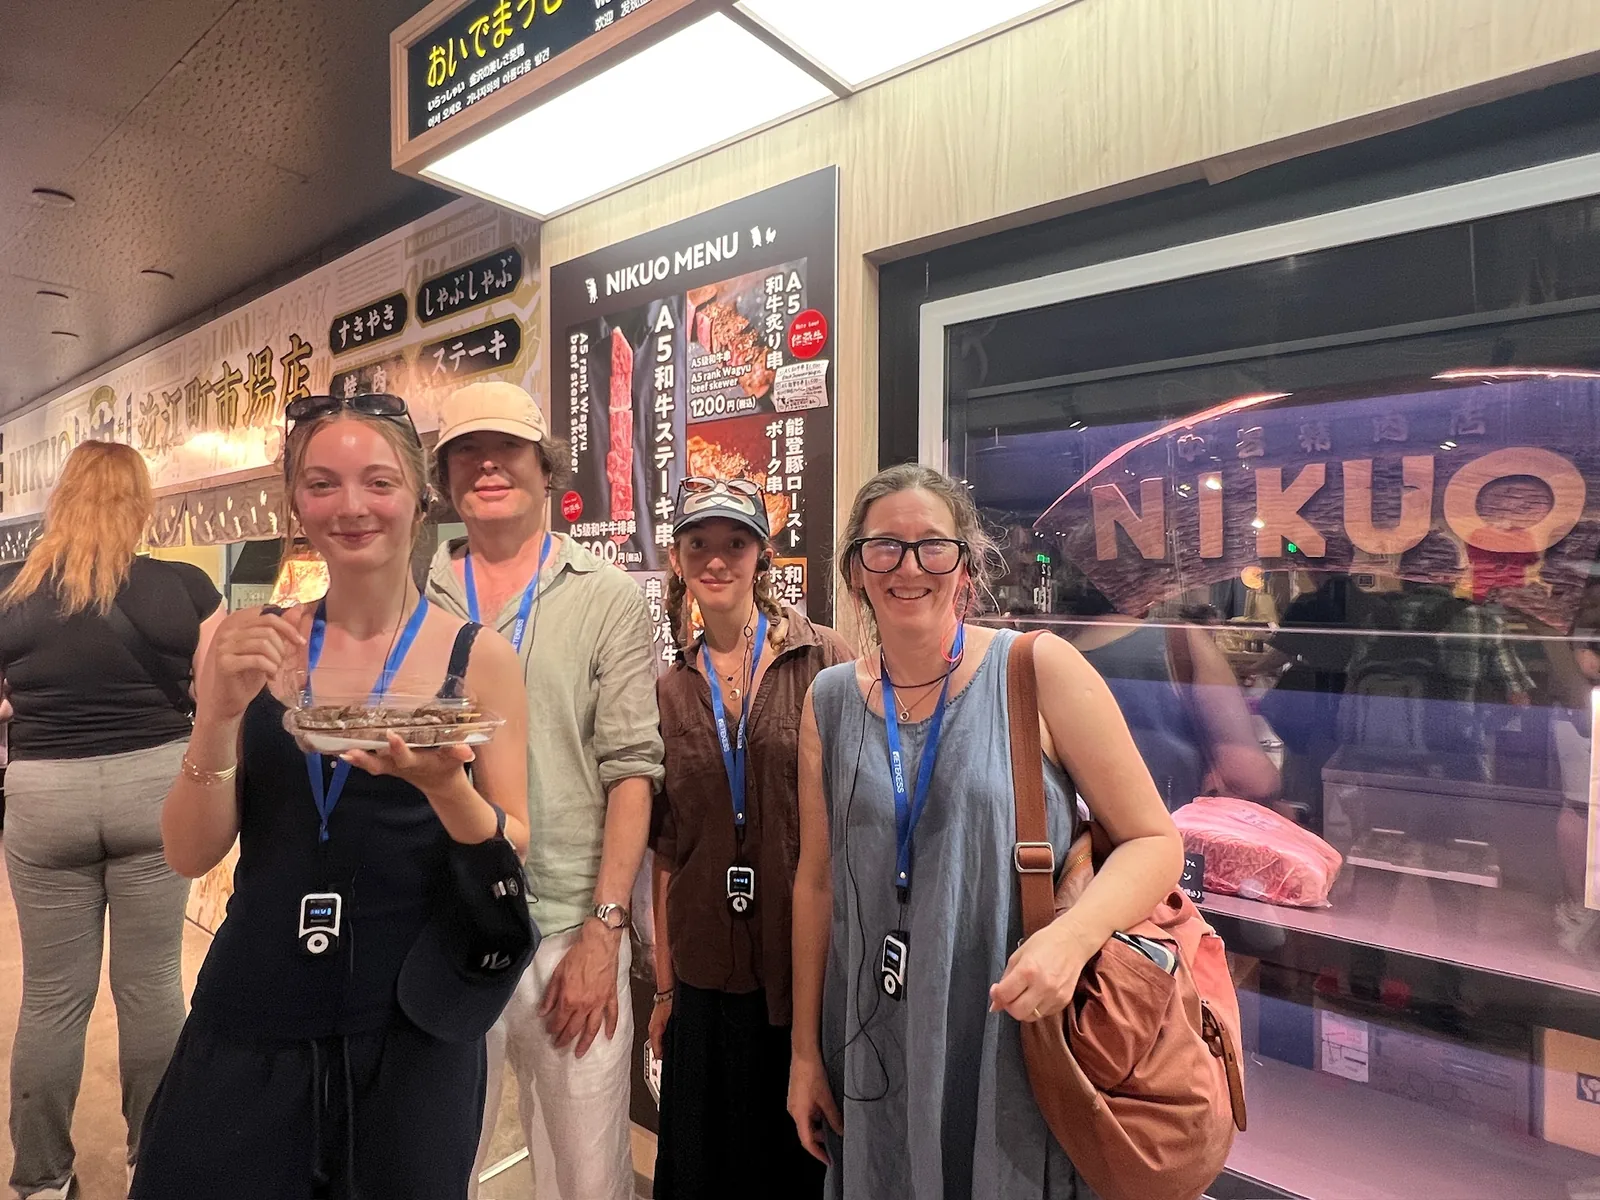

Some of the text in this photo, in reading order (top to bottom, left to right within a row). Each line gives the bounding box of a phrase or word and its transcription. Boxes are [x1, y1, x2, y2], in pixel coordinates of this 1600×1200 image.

[427, 81, 465, 111] いらっしゃい
[427, 112, 441, 128] 어서
[425, 255, 513, 317] しゃぶしゃぶ
[605, 231, 739, 296] NIKUO MENU
[786, 271, 802, 315] A5
[338, 304, 395, 349] すきやき
[431, 329, 508, 377] ステーキ
[765, 275, 785, 370] 和牛炙り串
[137, 332, 313, 456] 近江町市場店
[570, 334, 580, 474] beef steak skewer
[579, 332, 589, 451] A5 rank Wagyu
[690, 377, 738, 394] beef skewer
[691, 363, 752, 384] A5 rank Wagyu
[654, 304, 675, 548] A5和牛ステーキ串
[765, 419, 784, 495] ポーク串
[9, 430, 71, 497] NIKUO
[785, 417, 804, 548] 能登豚ロースト
[1090, 446, 1588, 561] NIKUO
[784, 565, 804, 604] 和牛
